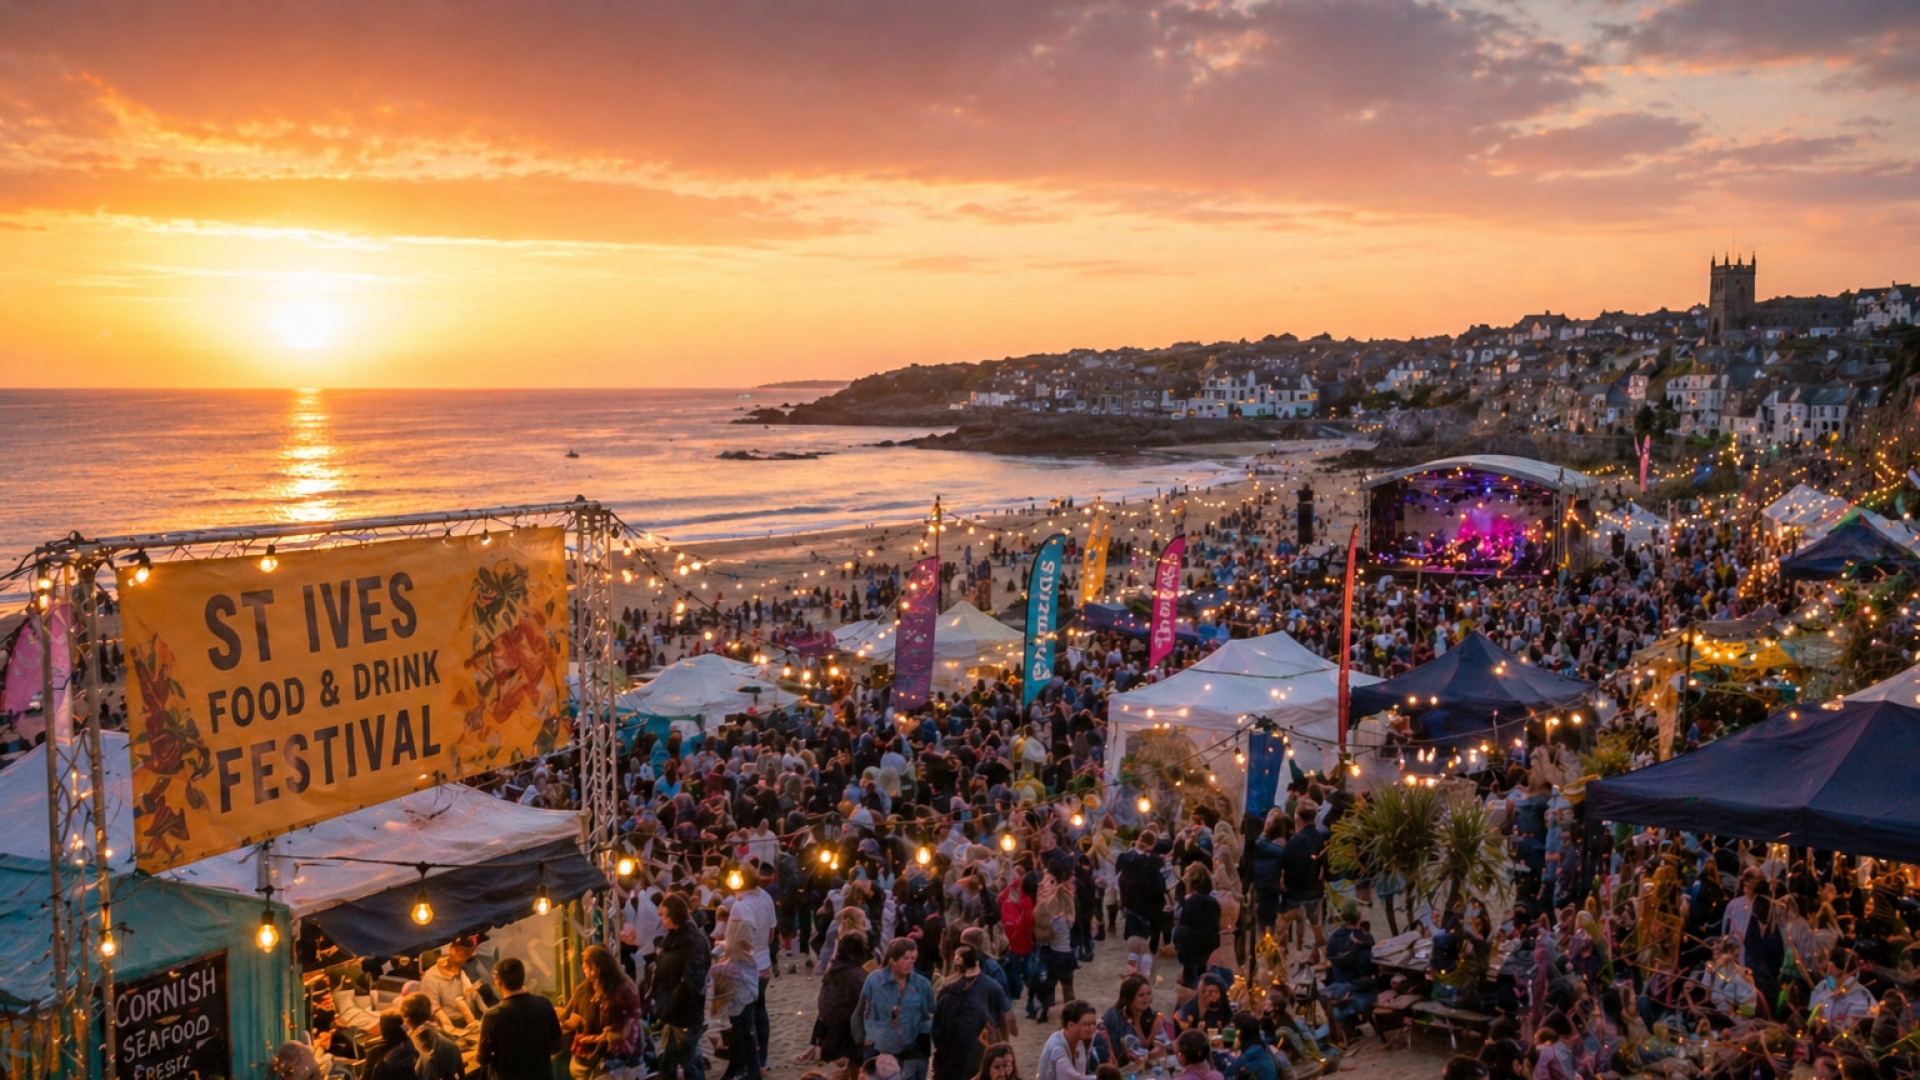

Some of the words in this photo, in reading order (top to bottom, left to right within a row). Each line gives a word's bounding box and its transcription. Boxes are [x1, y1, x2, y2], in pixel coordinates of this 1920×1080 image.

[204, 589, 275, 671] ST
[302, 572, 417, 653] IVES
[208, 677, 305, 734] FOOD
[319, 669, 341, 708] &
[353, 649, 441, 701] DRINK
[216, 704, 441, 813] FESTIVAL
[115, 966, 216, 1028] CORNISH
[123, 1015, 210, 1063] SEAFOOD
